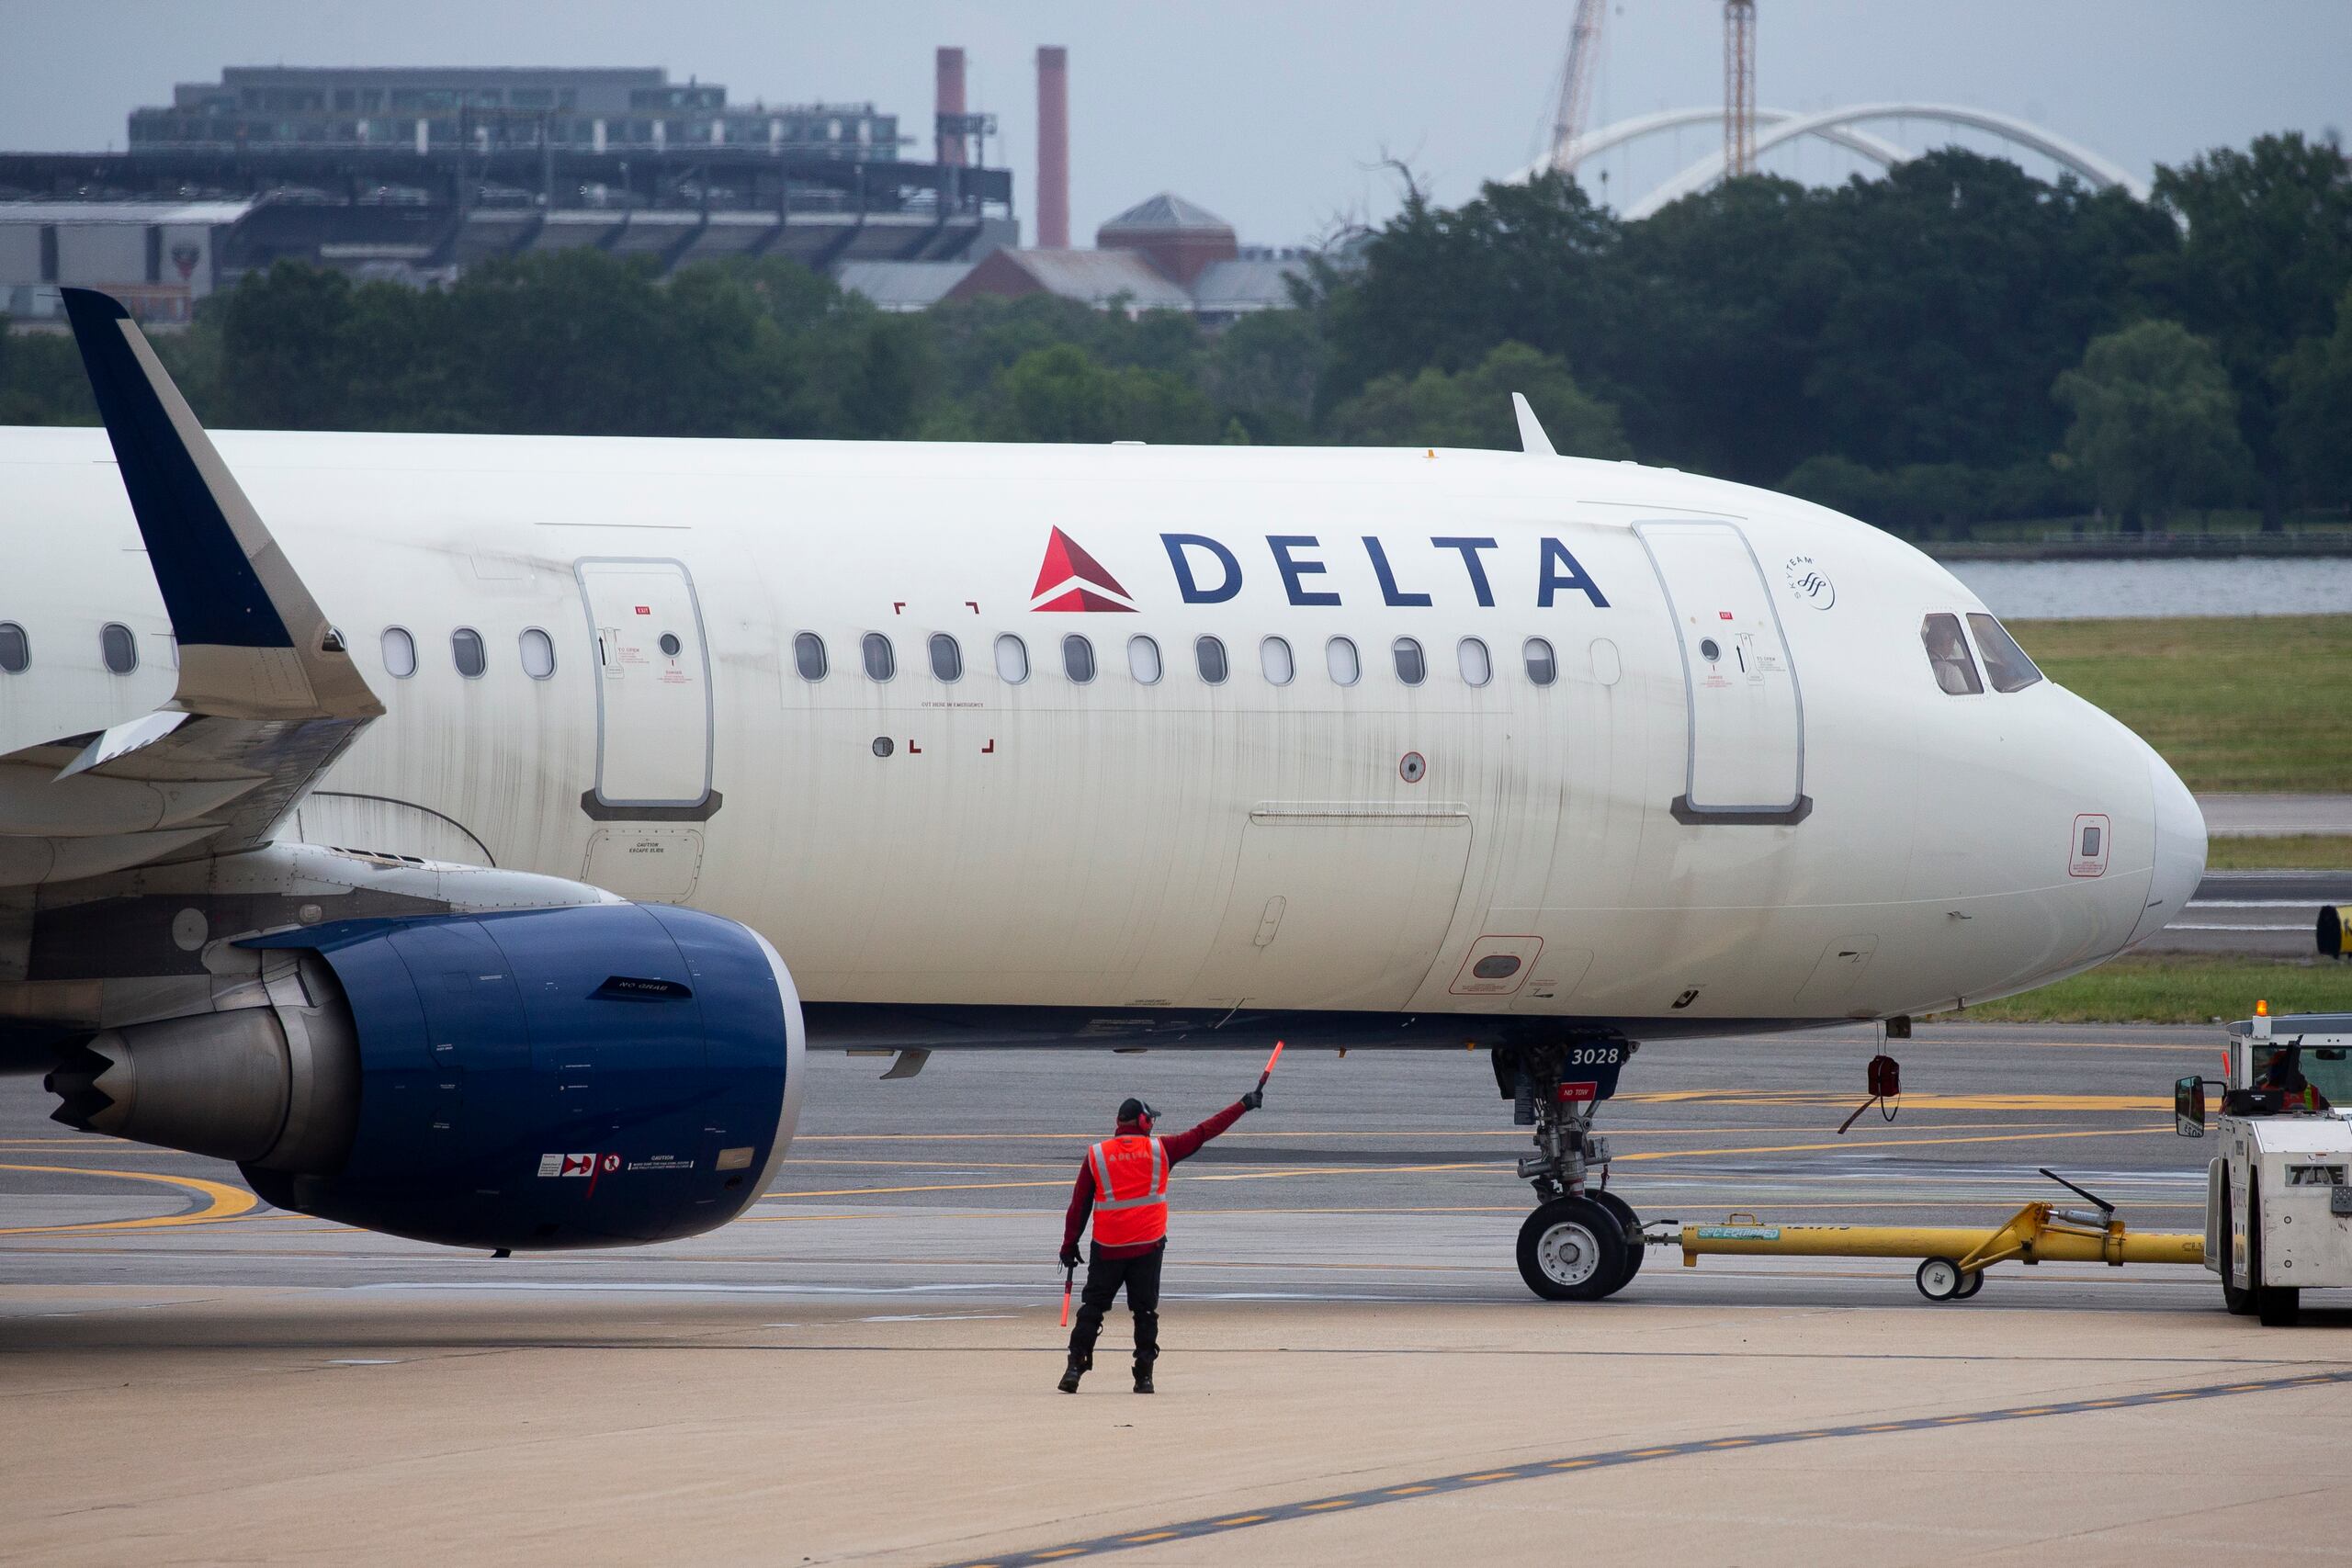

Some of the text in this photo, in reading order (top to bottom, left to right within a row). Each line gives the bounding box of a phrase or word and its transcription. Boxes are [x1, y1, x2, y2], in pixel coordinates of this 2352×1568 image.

[1159, 532, 1611, 607] DELTA
[1785, 556, 1813, 599] SKYTEAM
[1571, 1048, 1619, 1065] 3028
